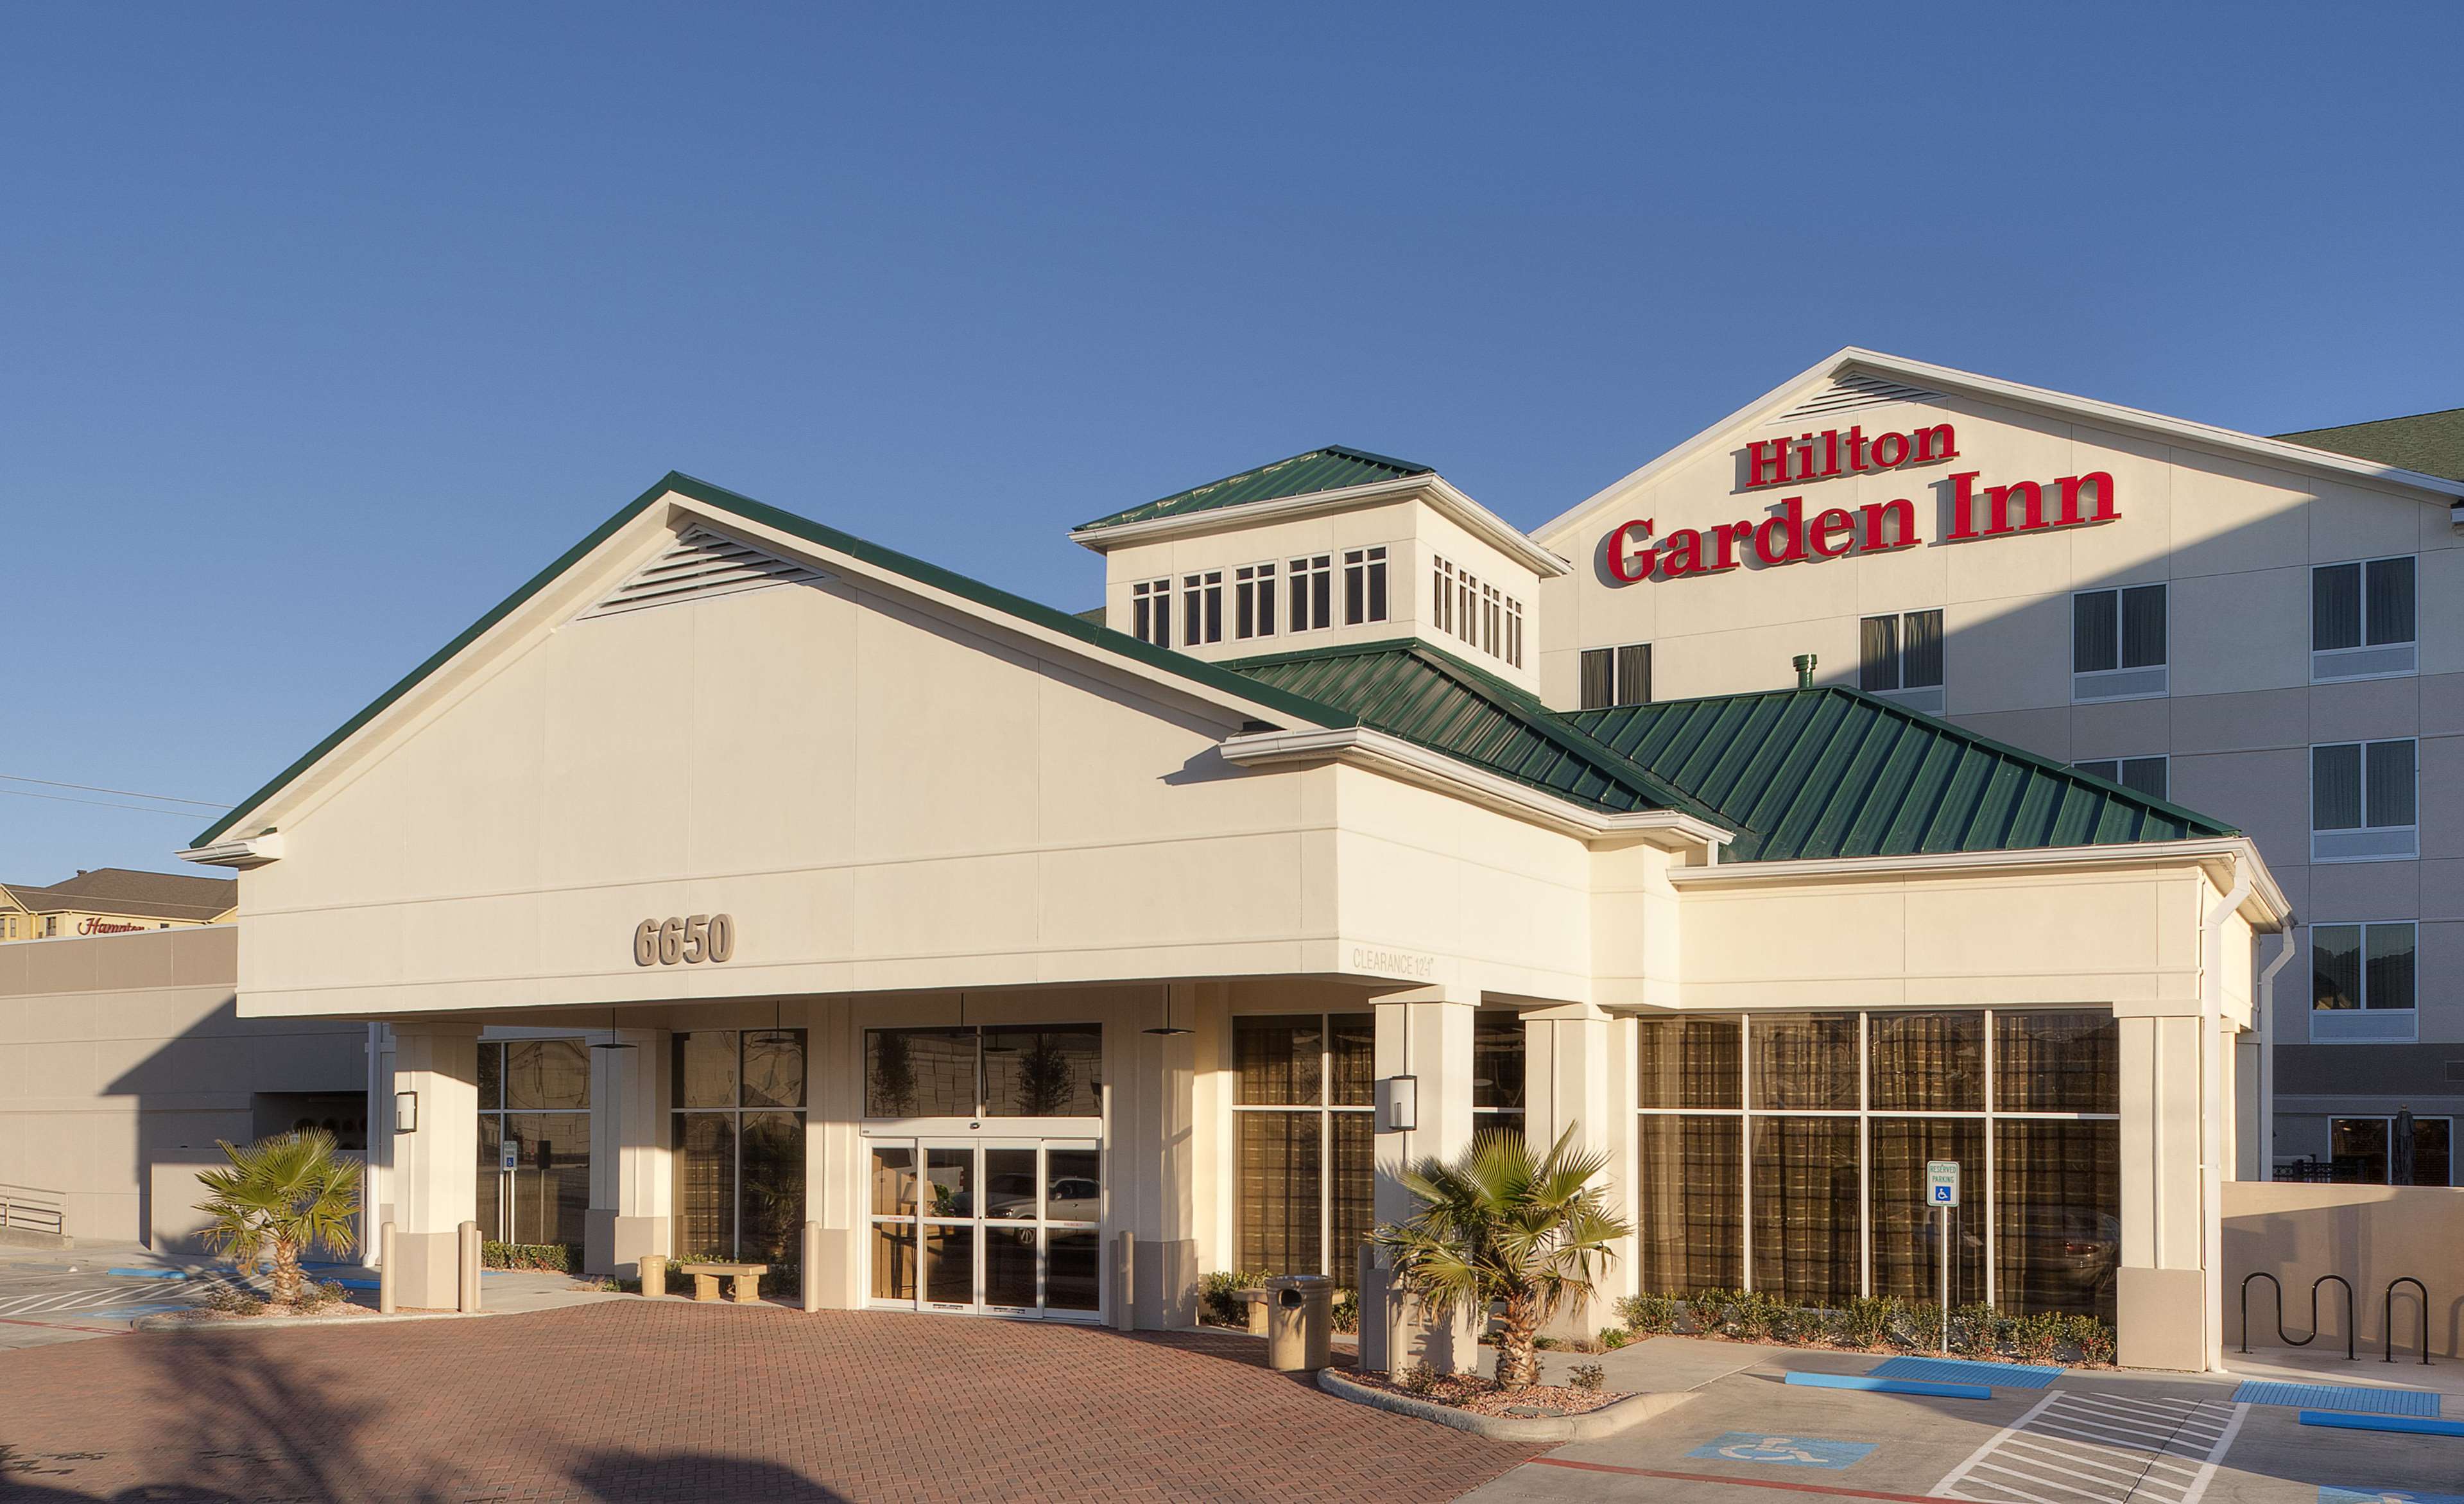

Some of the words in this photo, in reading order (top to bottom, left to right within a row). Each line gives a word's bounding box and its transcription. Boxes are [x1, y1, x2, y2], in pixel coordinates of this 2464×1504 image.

[1745, 422, 1961, 489] Hilton
[1605, 496, 1922, 585] Garden
[1945, 470, 2123, 541] Inn
[634, 913, 736, 967] 6650
[1353, 948, 1413, 974] CLEARANCE
[1930, 1165, 1956, 1173] RESERVED
